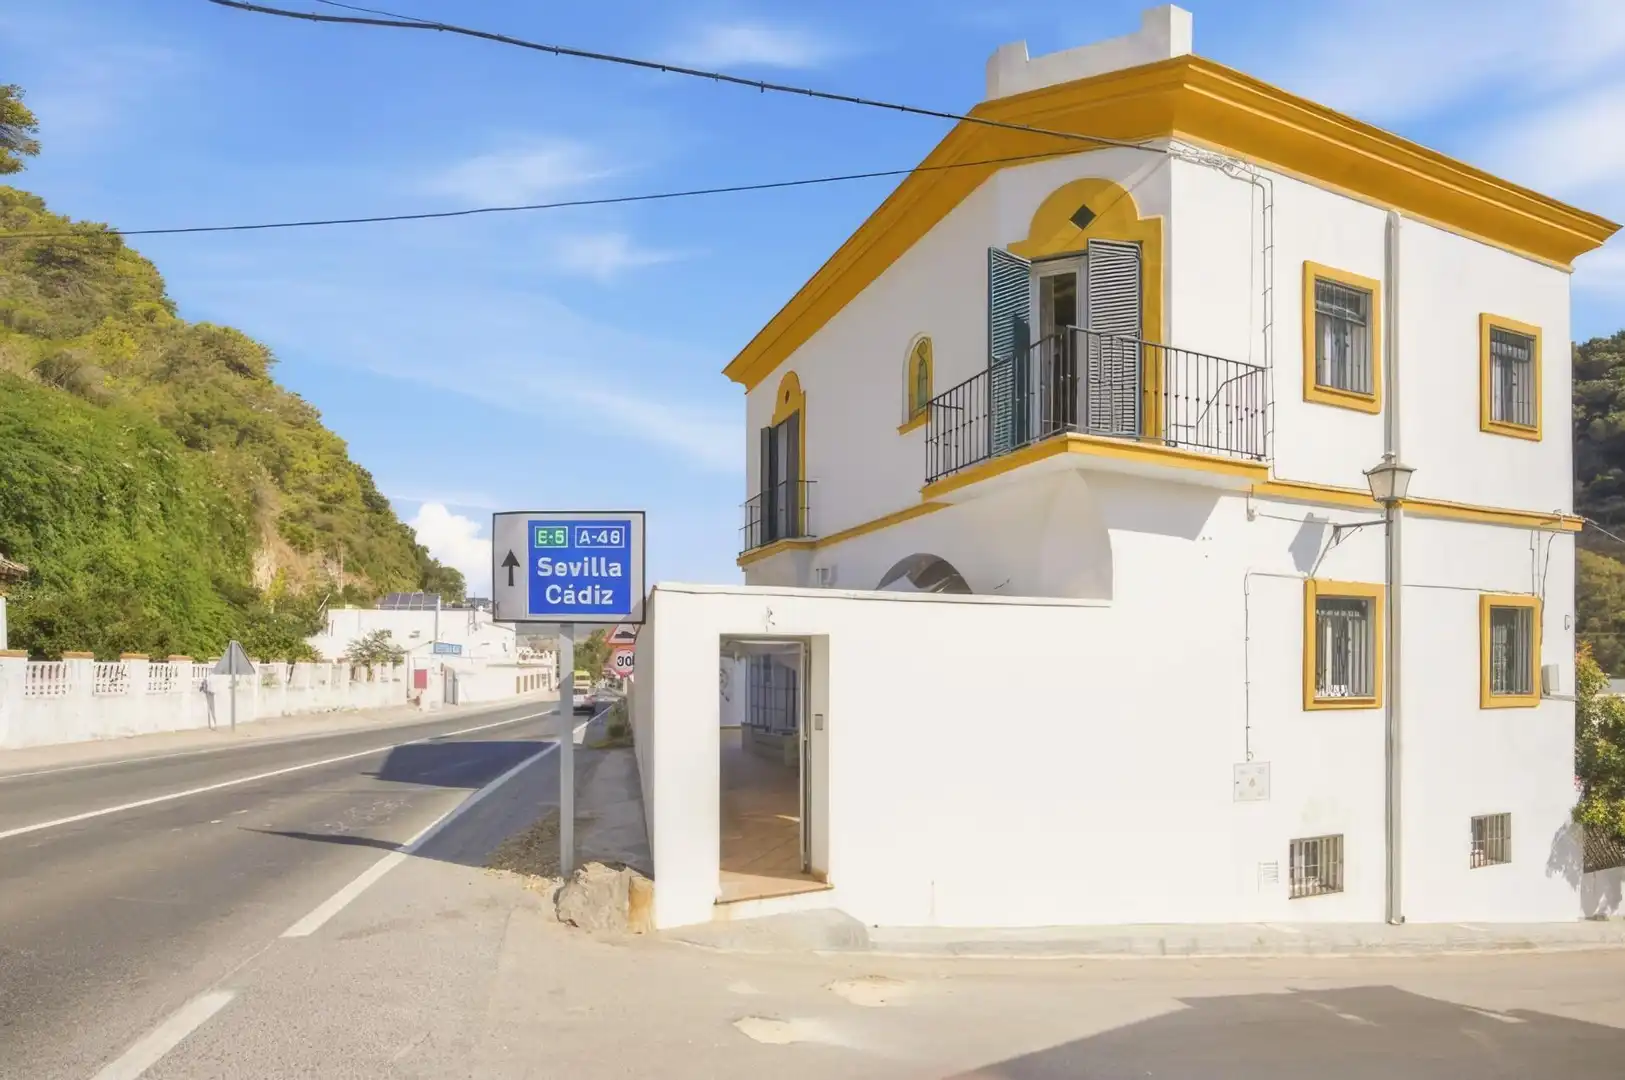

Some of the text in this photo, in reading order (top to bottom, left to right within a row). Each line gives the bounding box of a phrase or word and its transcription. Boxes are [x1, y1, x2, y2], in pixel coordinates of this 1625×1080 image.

[579, 530, 620, 544] A-48
[537, 557, 622, 577] Sevilla
[545, 584, 613, 605] Cádiz
